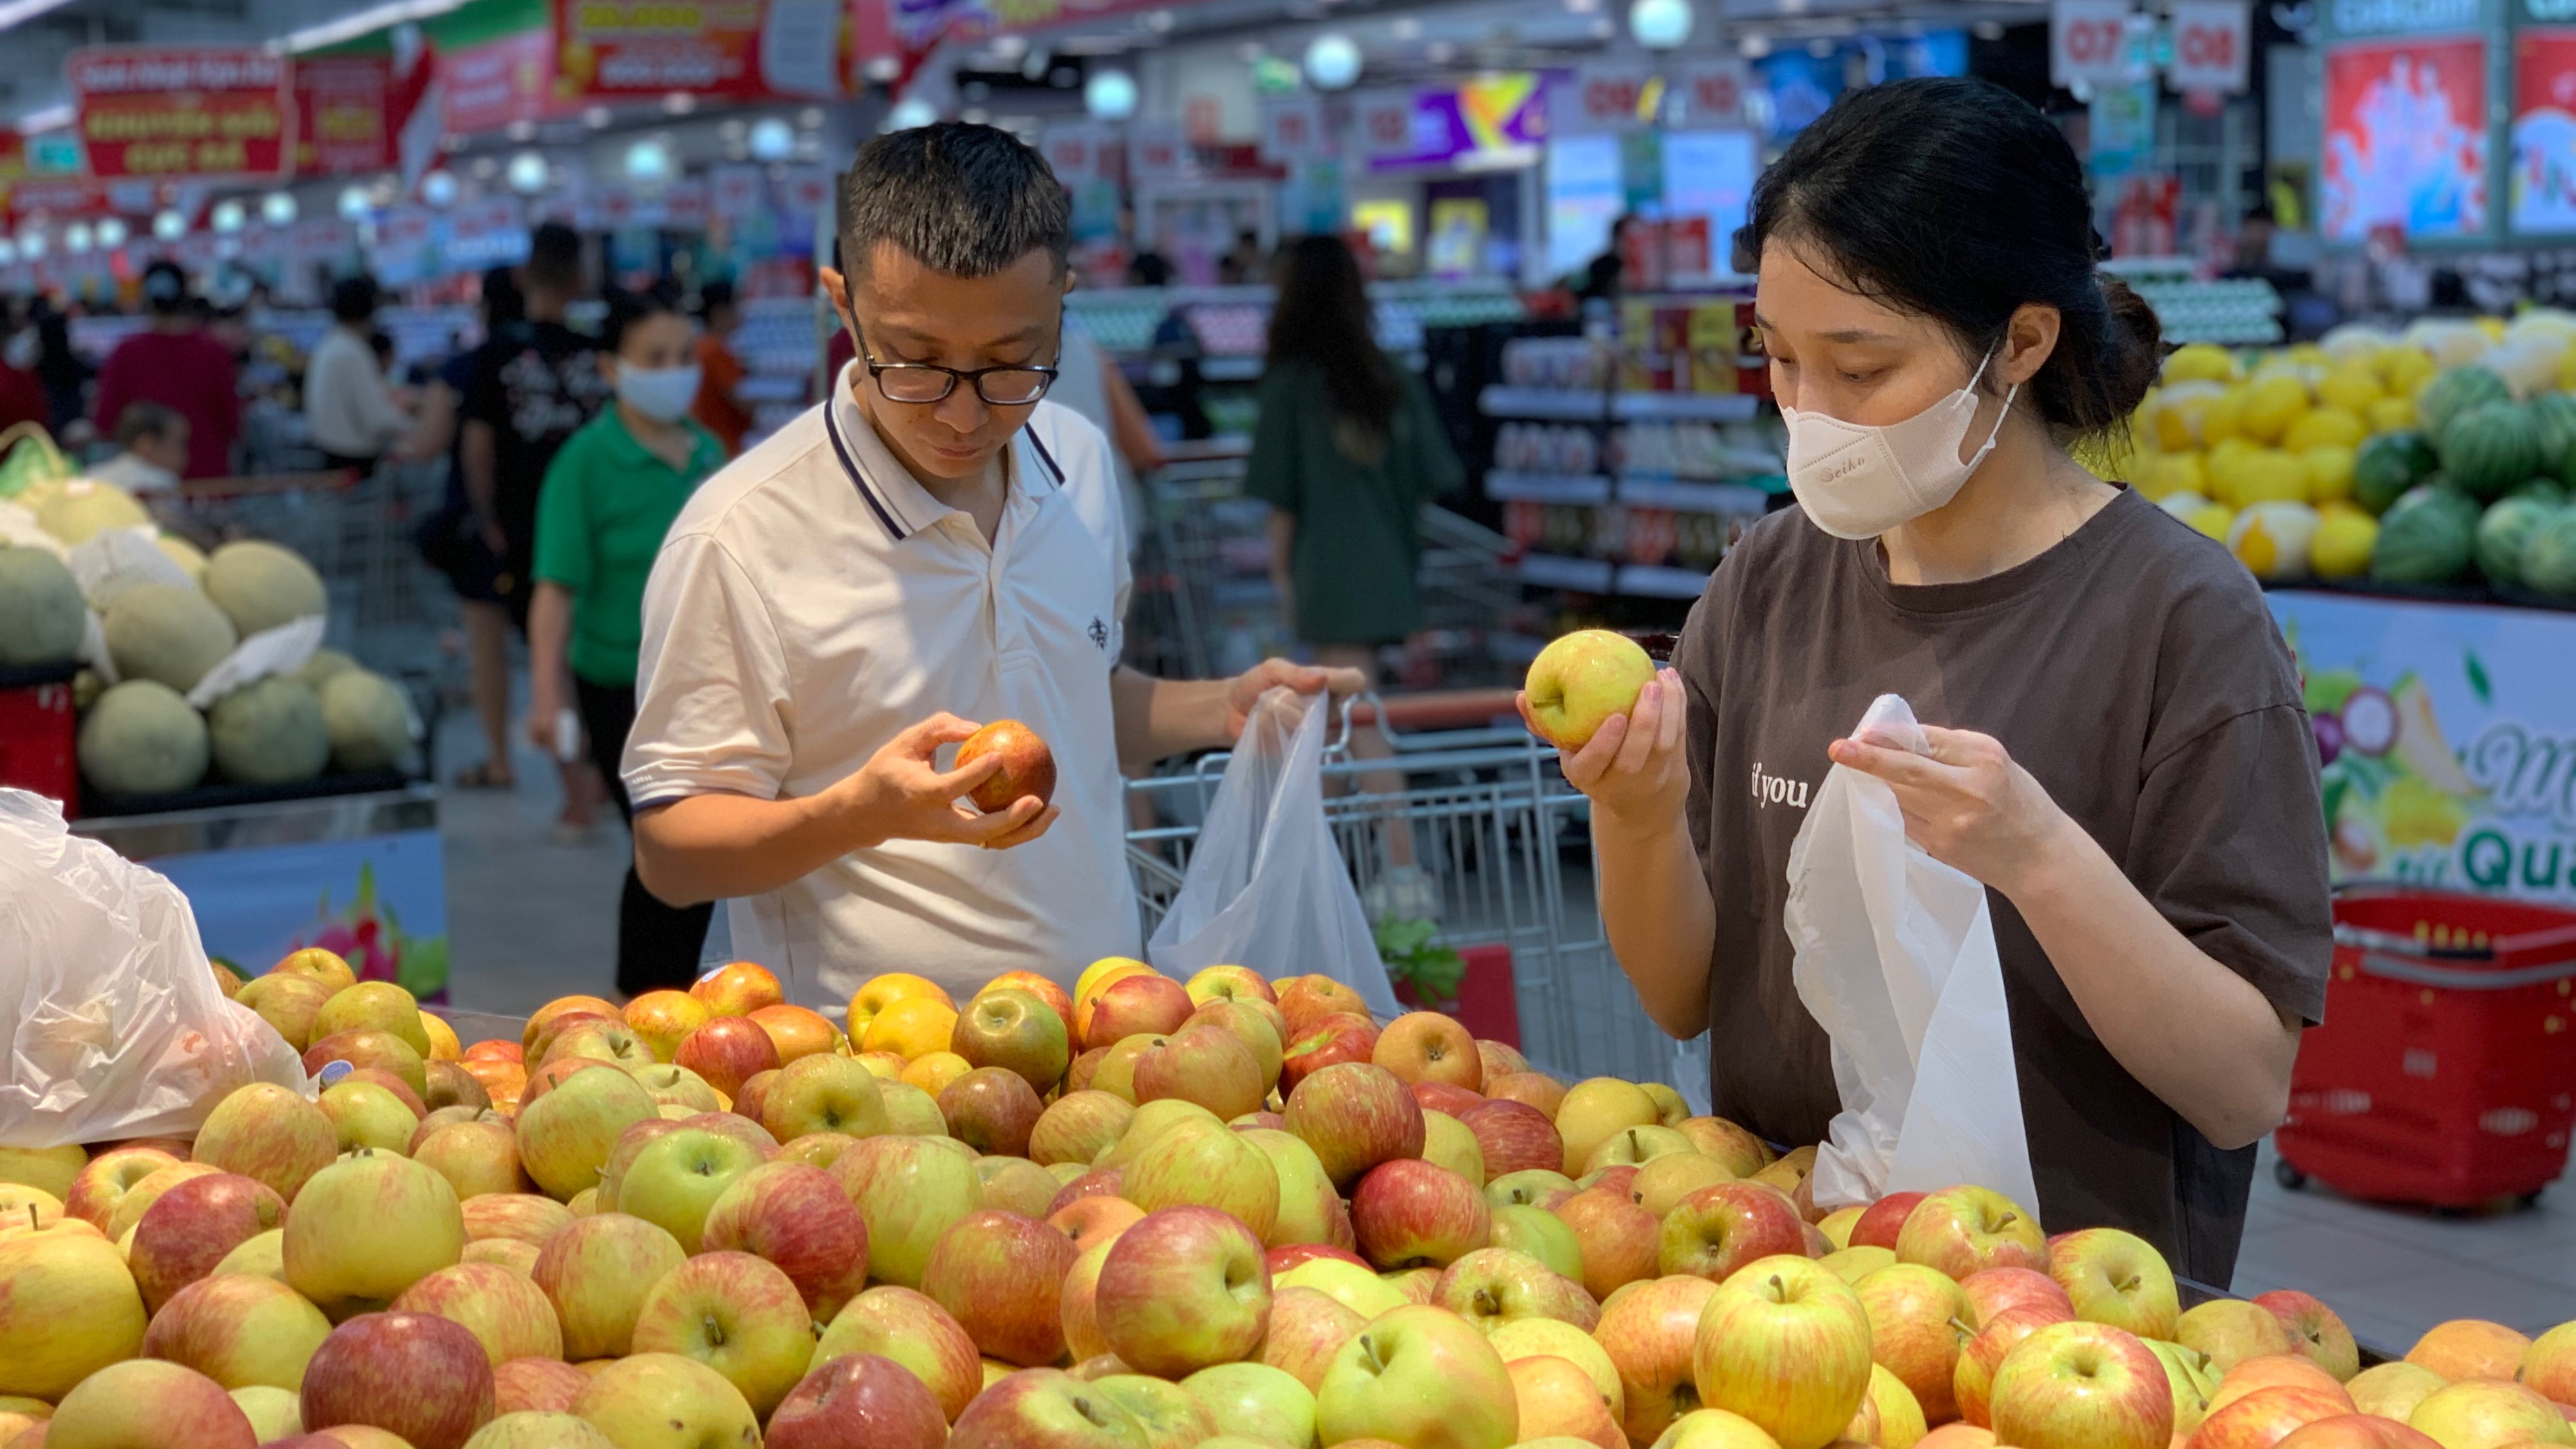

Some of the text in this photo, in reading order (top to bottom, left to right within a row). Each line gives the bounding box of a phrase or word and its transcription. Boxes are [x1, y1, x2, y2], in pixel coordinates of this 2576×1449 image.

[2066, 19, 2121, 62] 07
[2181, 24, 2234, 69] 08
[1820, 457, 1865, 482] Seiko
[1751, 762, 1808, 809] if you
